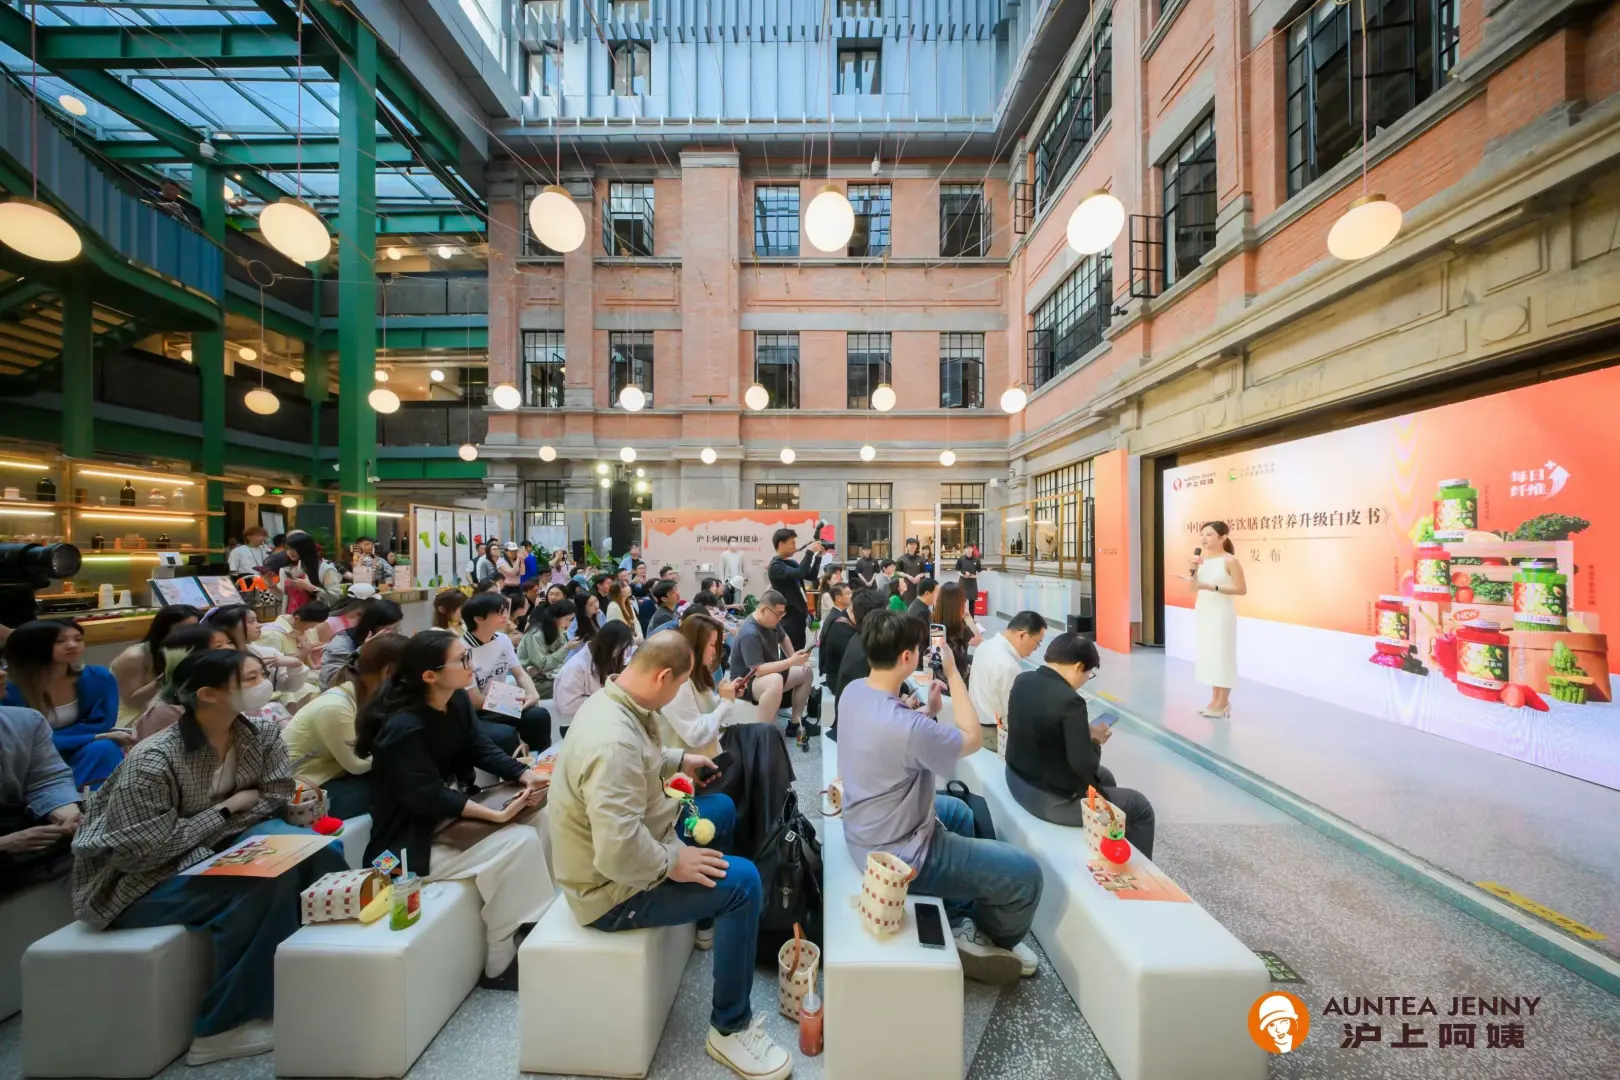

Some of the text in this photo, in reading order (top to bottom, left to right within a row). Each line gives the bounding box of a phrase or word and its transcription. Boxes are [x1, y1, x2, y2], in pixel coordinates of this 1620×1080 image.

[1511, 468, 1545, 483] 每日
[1510, 482, 1547, 497] 纤维
[1182, 507, 1391, 534] 《中茶饮膳食营养升级白皮书》
[1456, 610, 1476, 620] NEW
